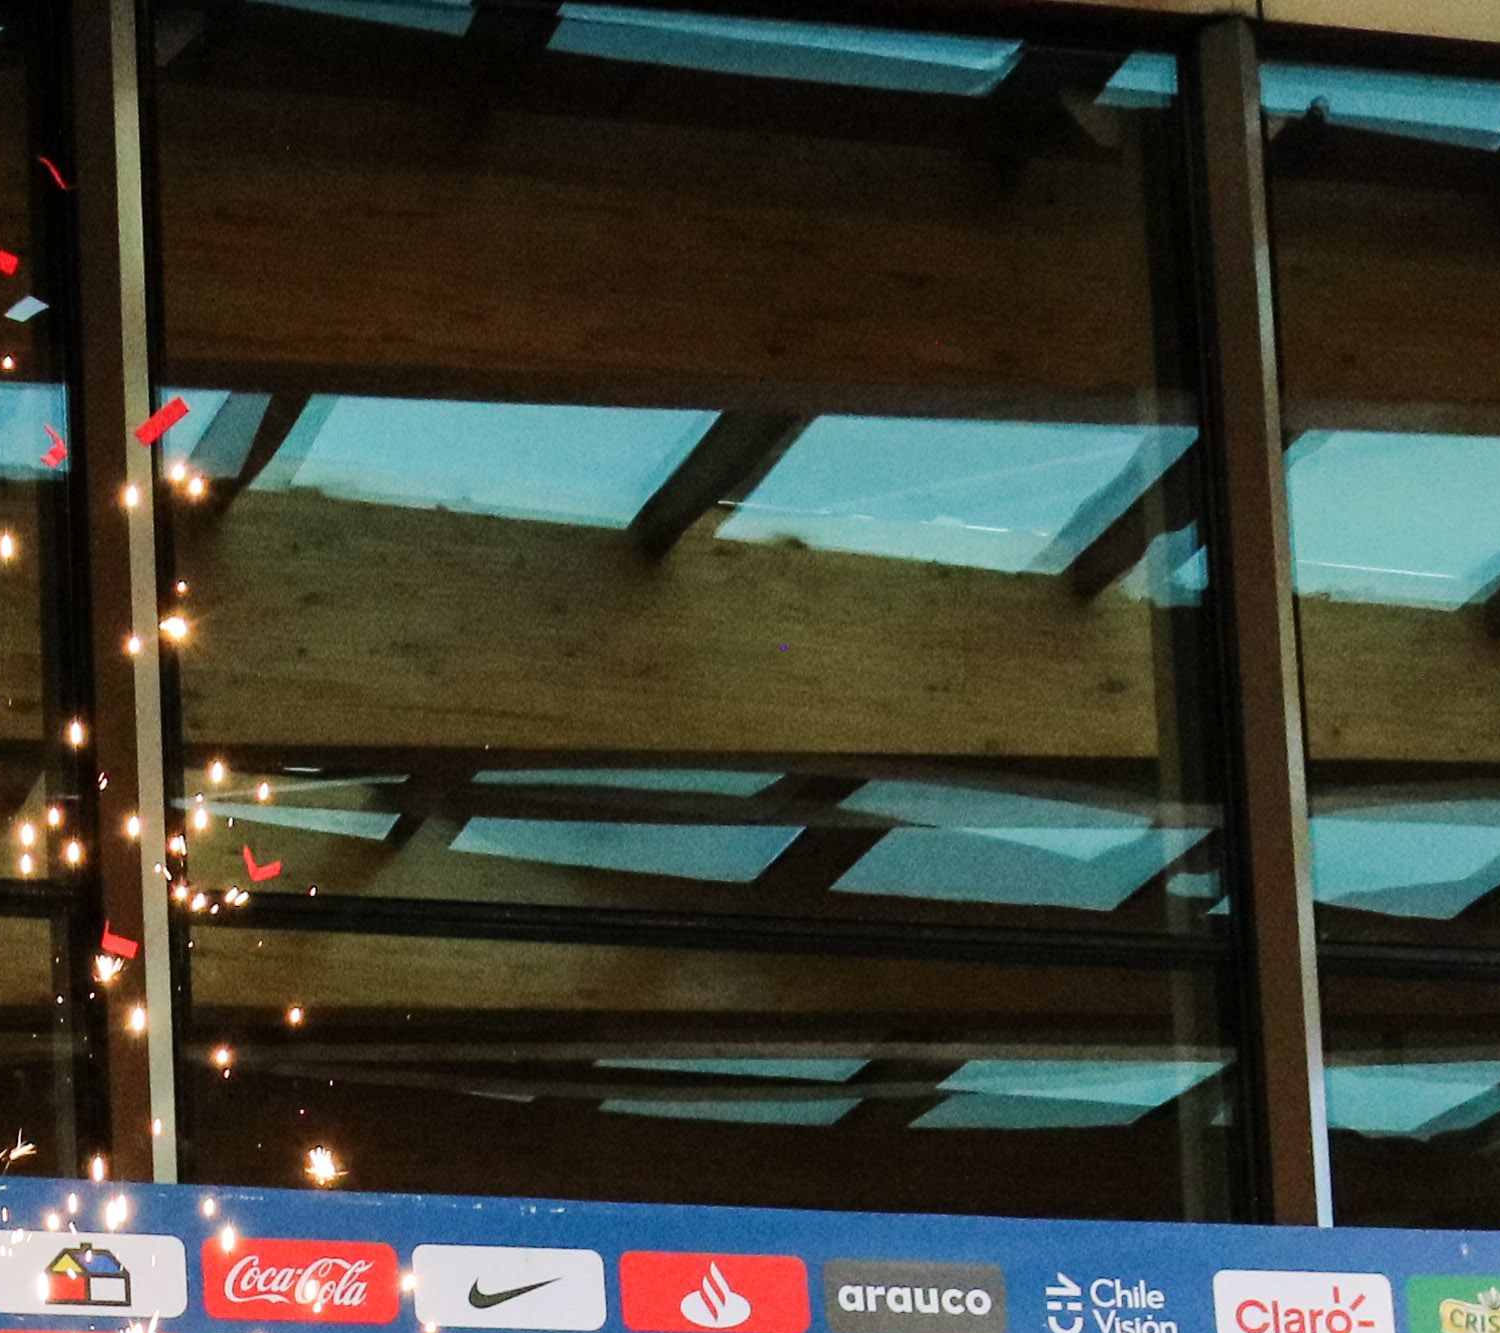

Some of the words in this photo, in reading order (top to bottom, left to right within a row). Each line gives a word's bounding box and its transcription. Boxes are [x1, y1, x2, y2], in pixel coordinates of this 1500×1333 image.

[222, 1254, 376, 1307] Coca-Cola
[1089, 1277, 1165, 1309] Chile
[837, 1283, 992, 1316] arauco
